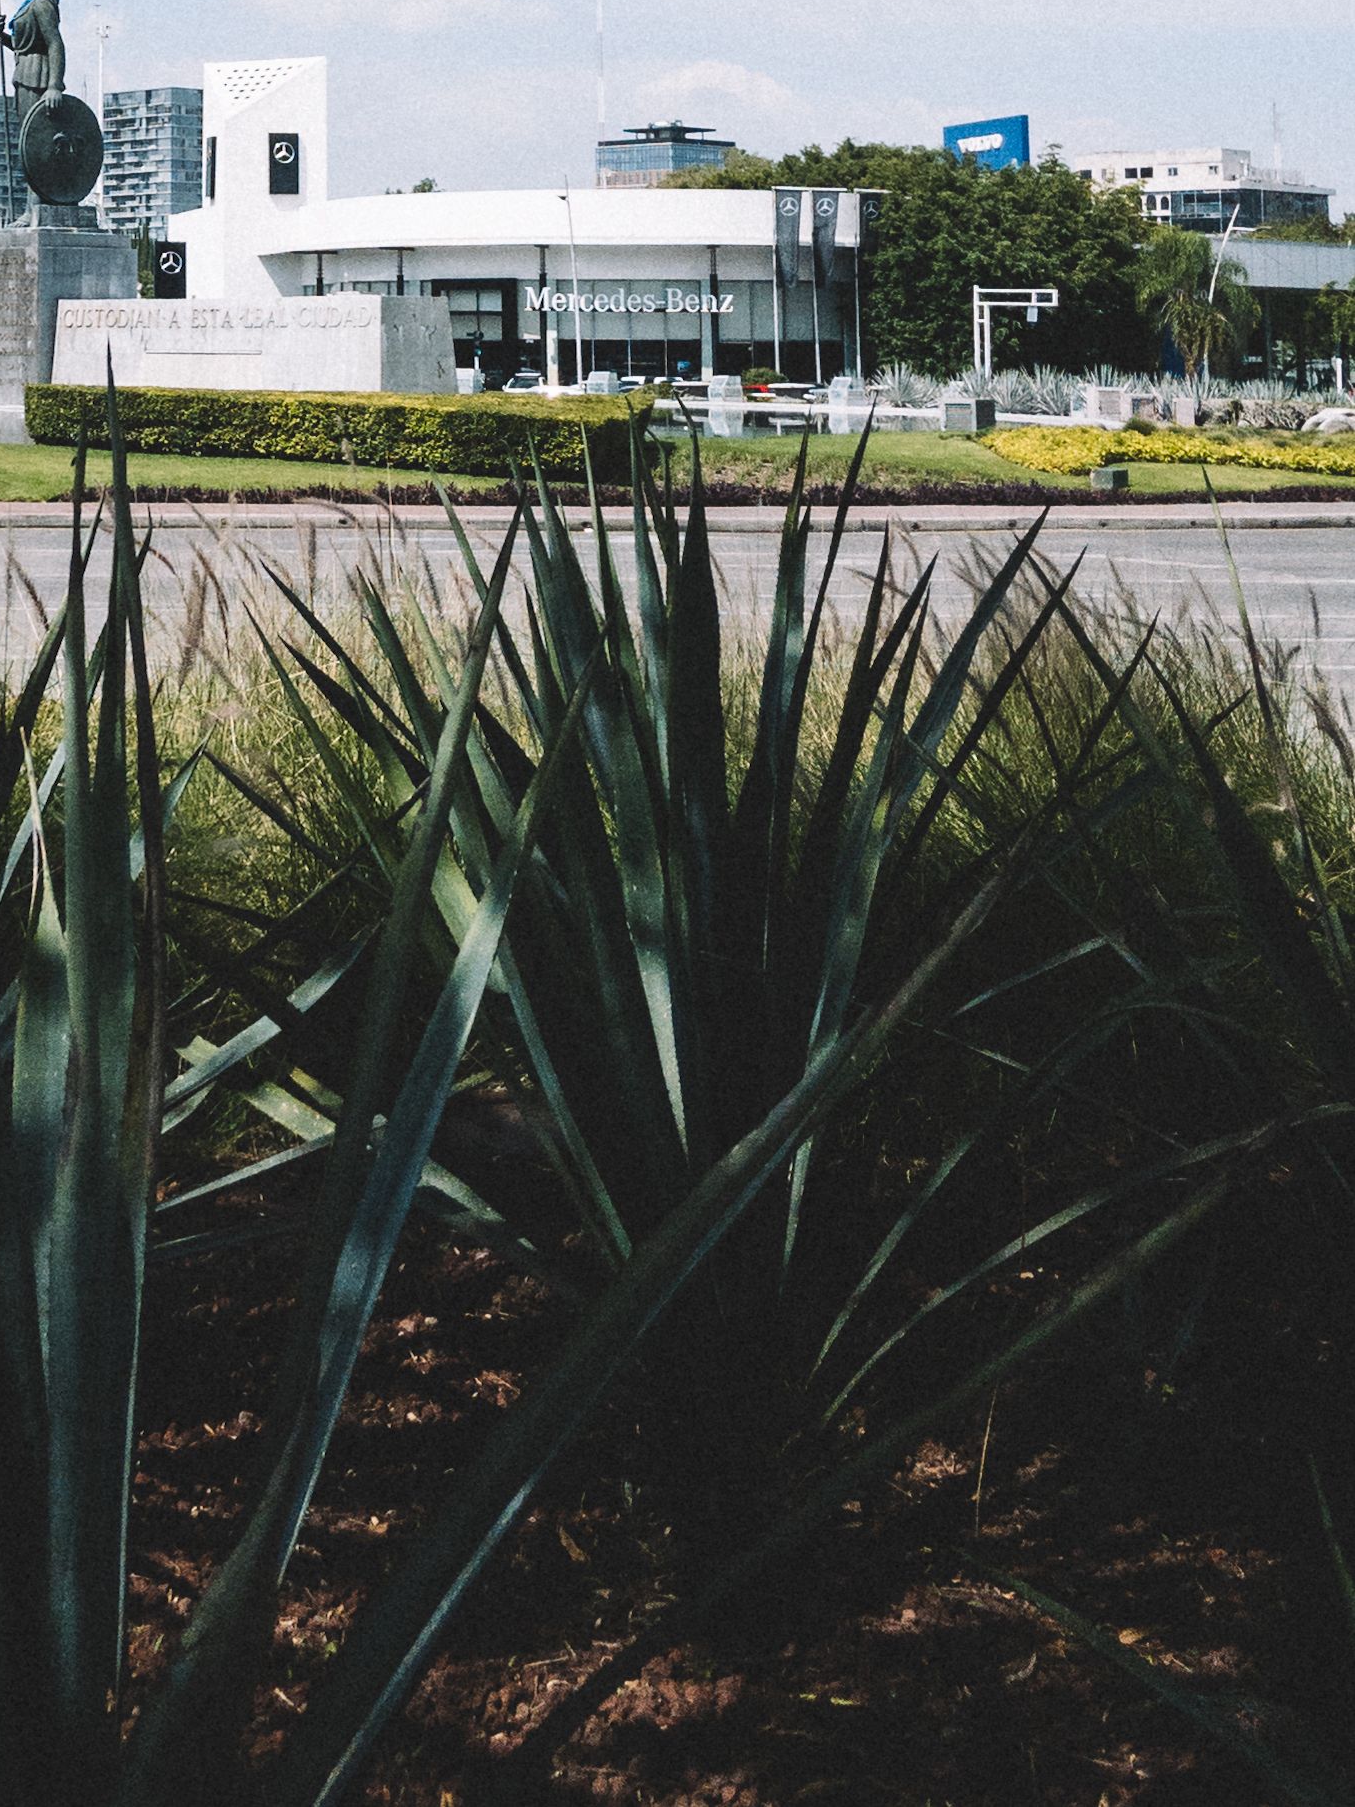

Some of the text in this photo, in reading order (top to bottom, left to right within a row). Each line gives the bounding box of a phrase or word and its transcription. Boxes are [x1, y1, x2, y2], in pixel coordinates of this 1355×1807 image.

[524, 286, 734, 313] Mercedes-Benz
[63, 308, 160, 330] CUSTODIAN
[191, 309, 233, 329] ESTA
[298, 306, 373, 329] CIUDAD
